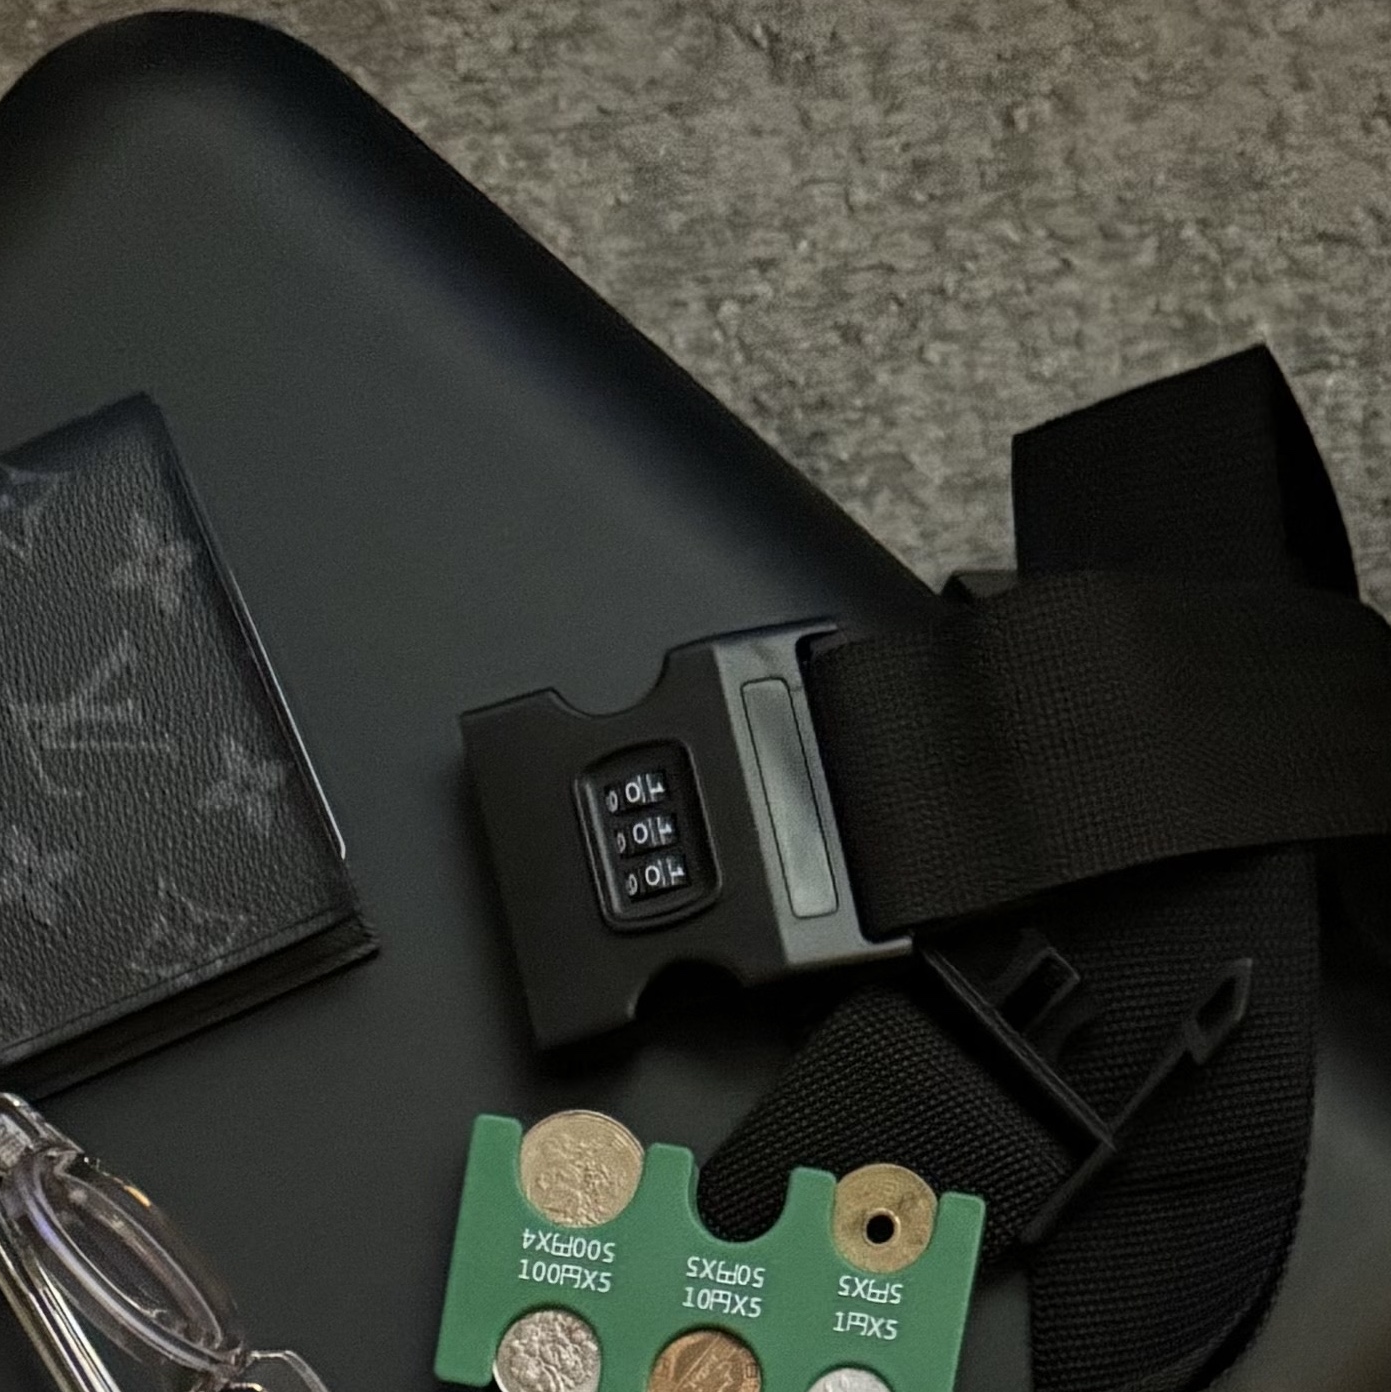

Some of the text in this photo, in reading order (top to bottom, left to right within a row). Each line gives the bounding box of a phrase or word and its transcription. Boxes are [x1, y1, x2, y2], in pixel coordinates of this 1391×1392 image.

[518, 1258, 612, 1293] 100円X5
[682, 1286, 762, 1318] 10円X5
[832, 1311, 899, 1341] 1円X5
